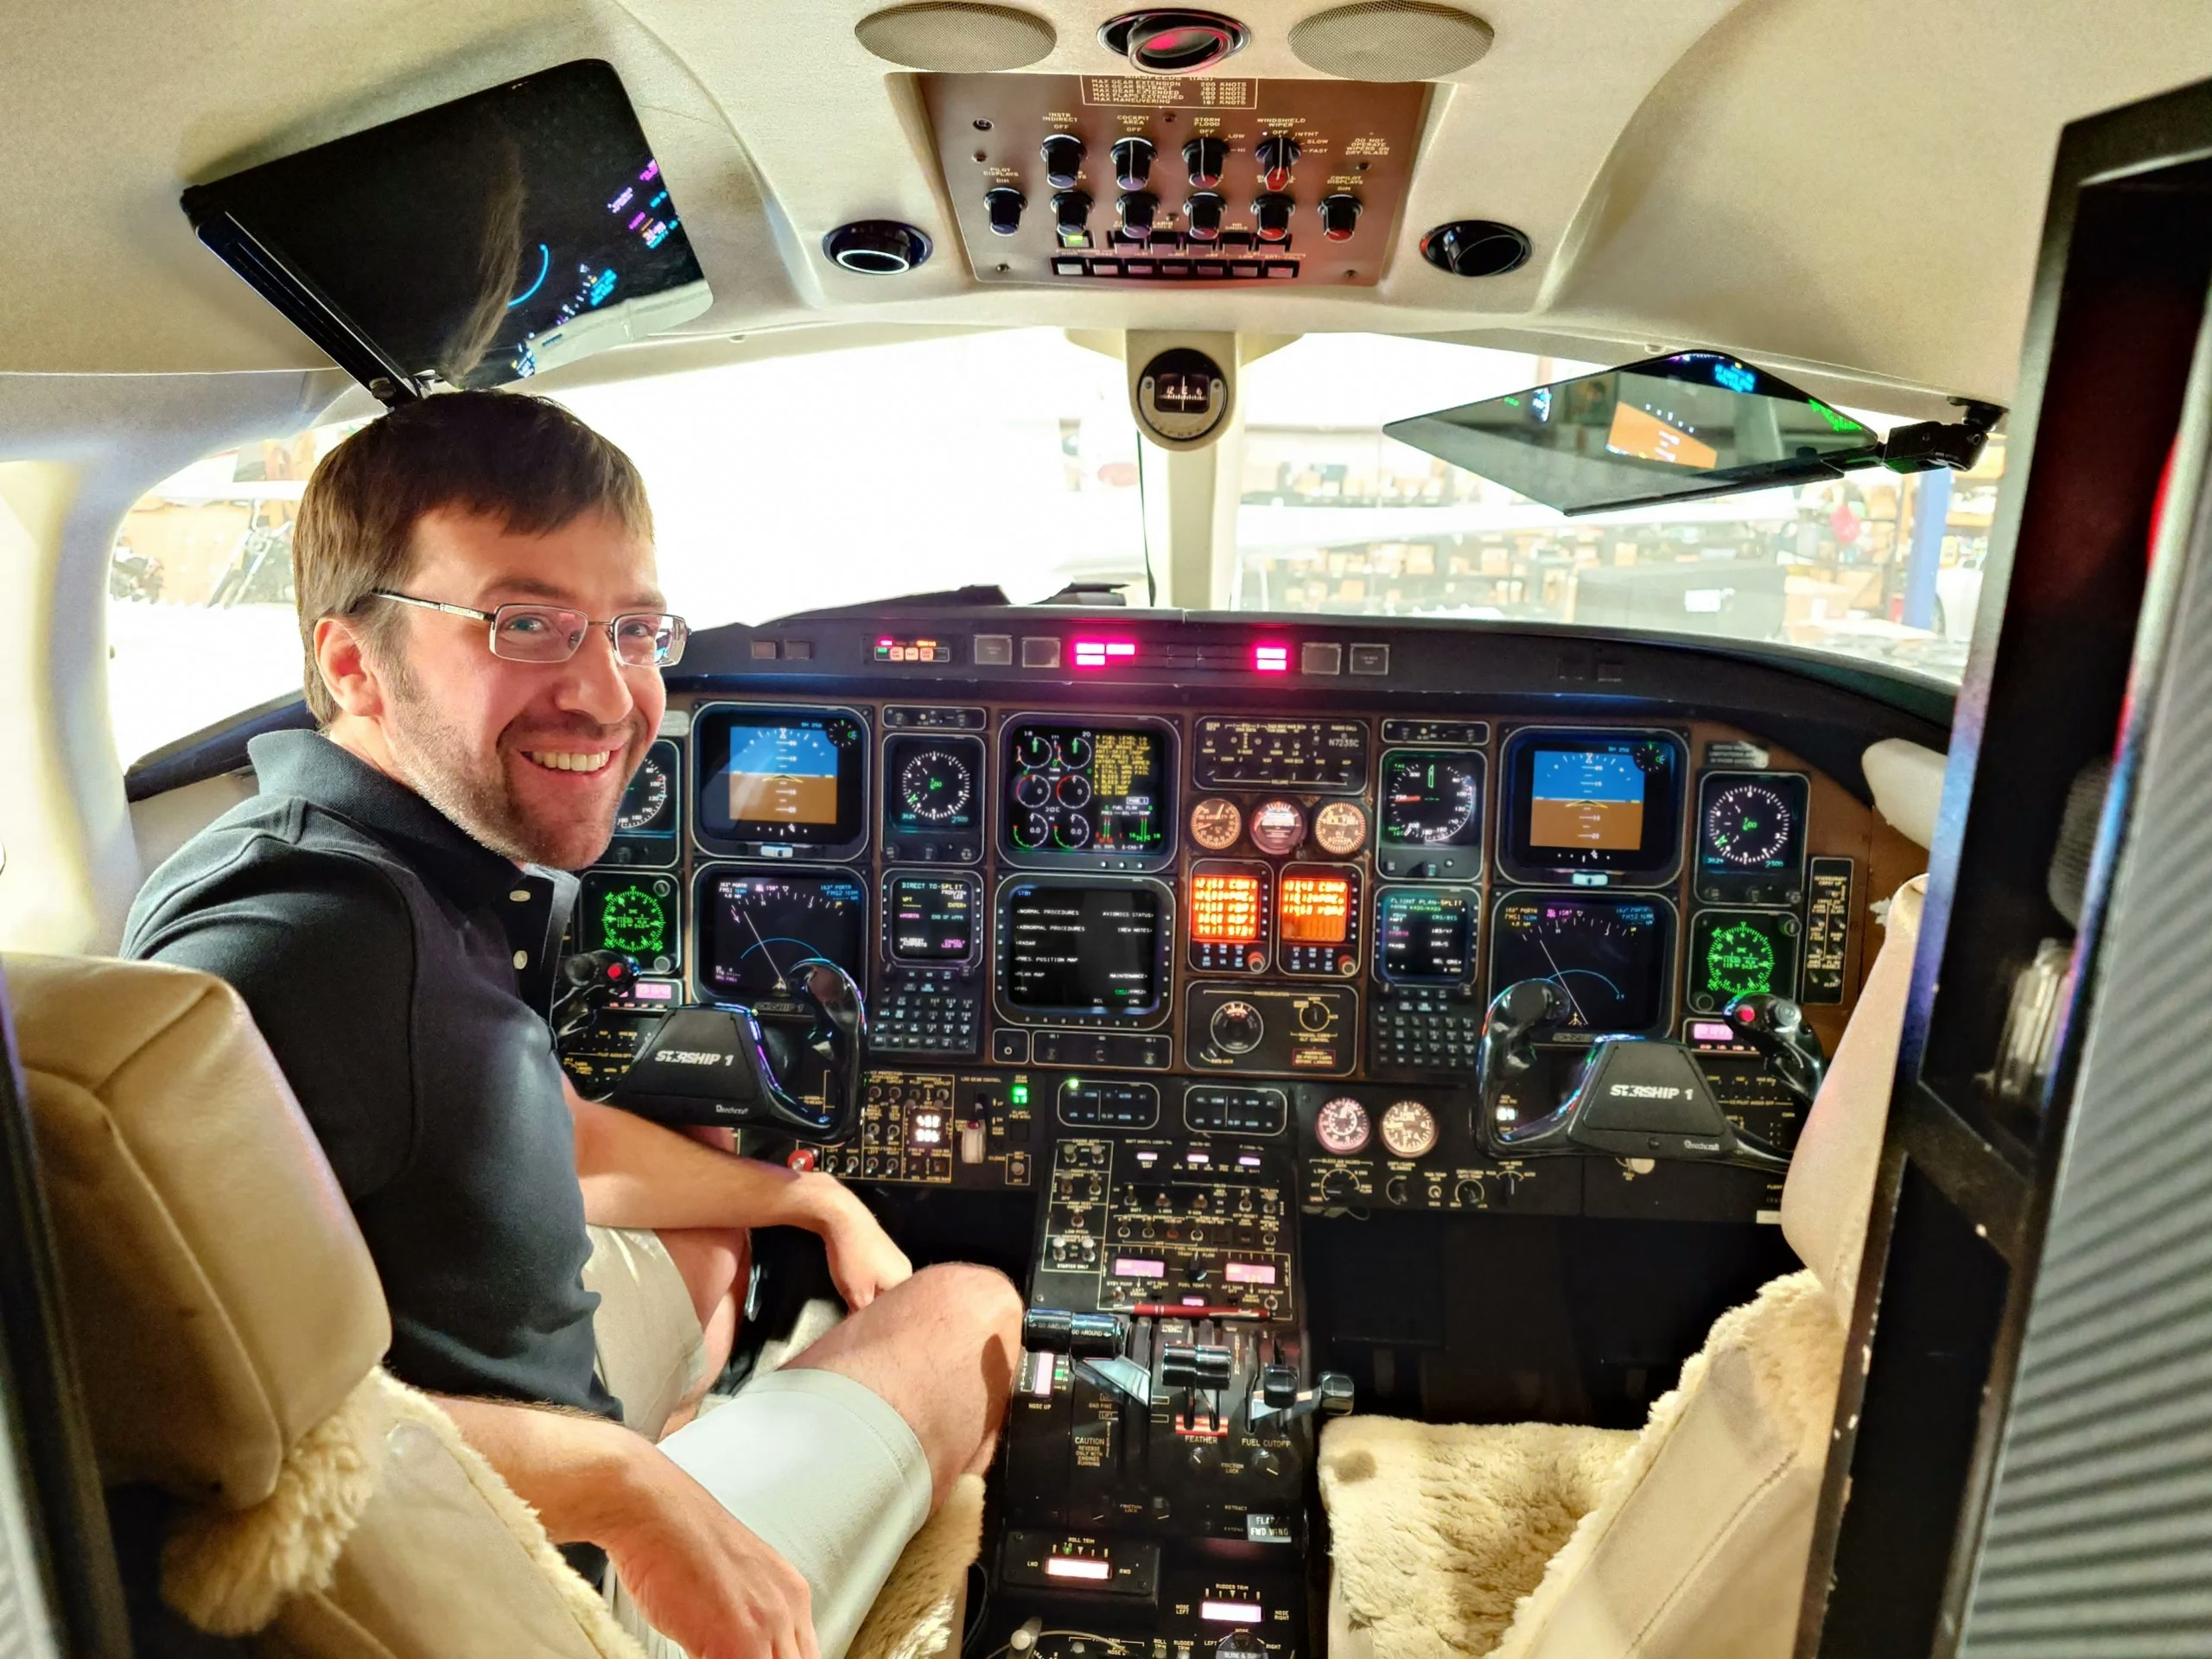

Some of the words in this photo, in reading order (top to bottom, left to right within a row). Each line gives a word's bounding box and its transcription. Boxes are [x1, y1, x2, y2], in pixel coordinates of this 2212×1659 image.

[725, 1054, 734, 1067] 1
[1684, 1089, 1694, 1101] 1
[1074, 1436, 1105, 1446] CAUTION
[1185, 1434, 1218, 1445] FEATHER
[1242, 1438, 1261, 1447] FUEL
[1262, 1440, 1292, 1448] CUTOFF
[1250, 1527, 1267, 1536] FWD
